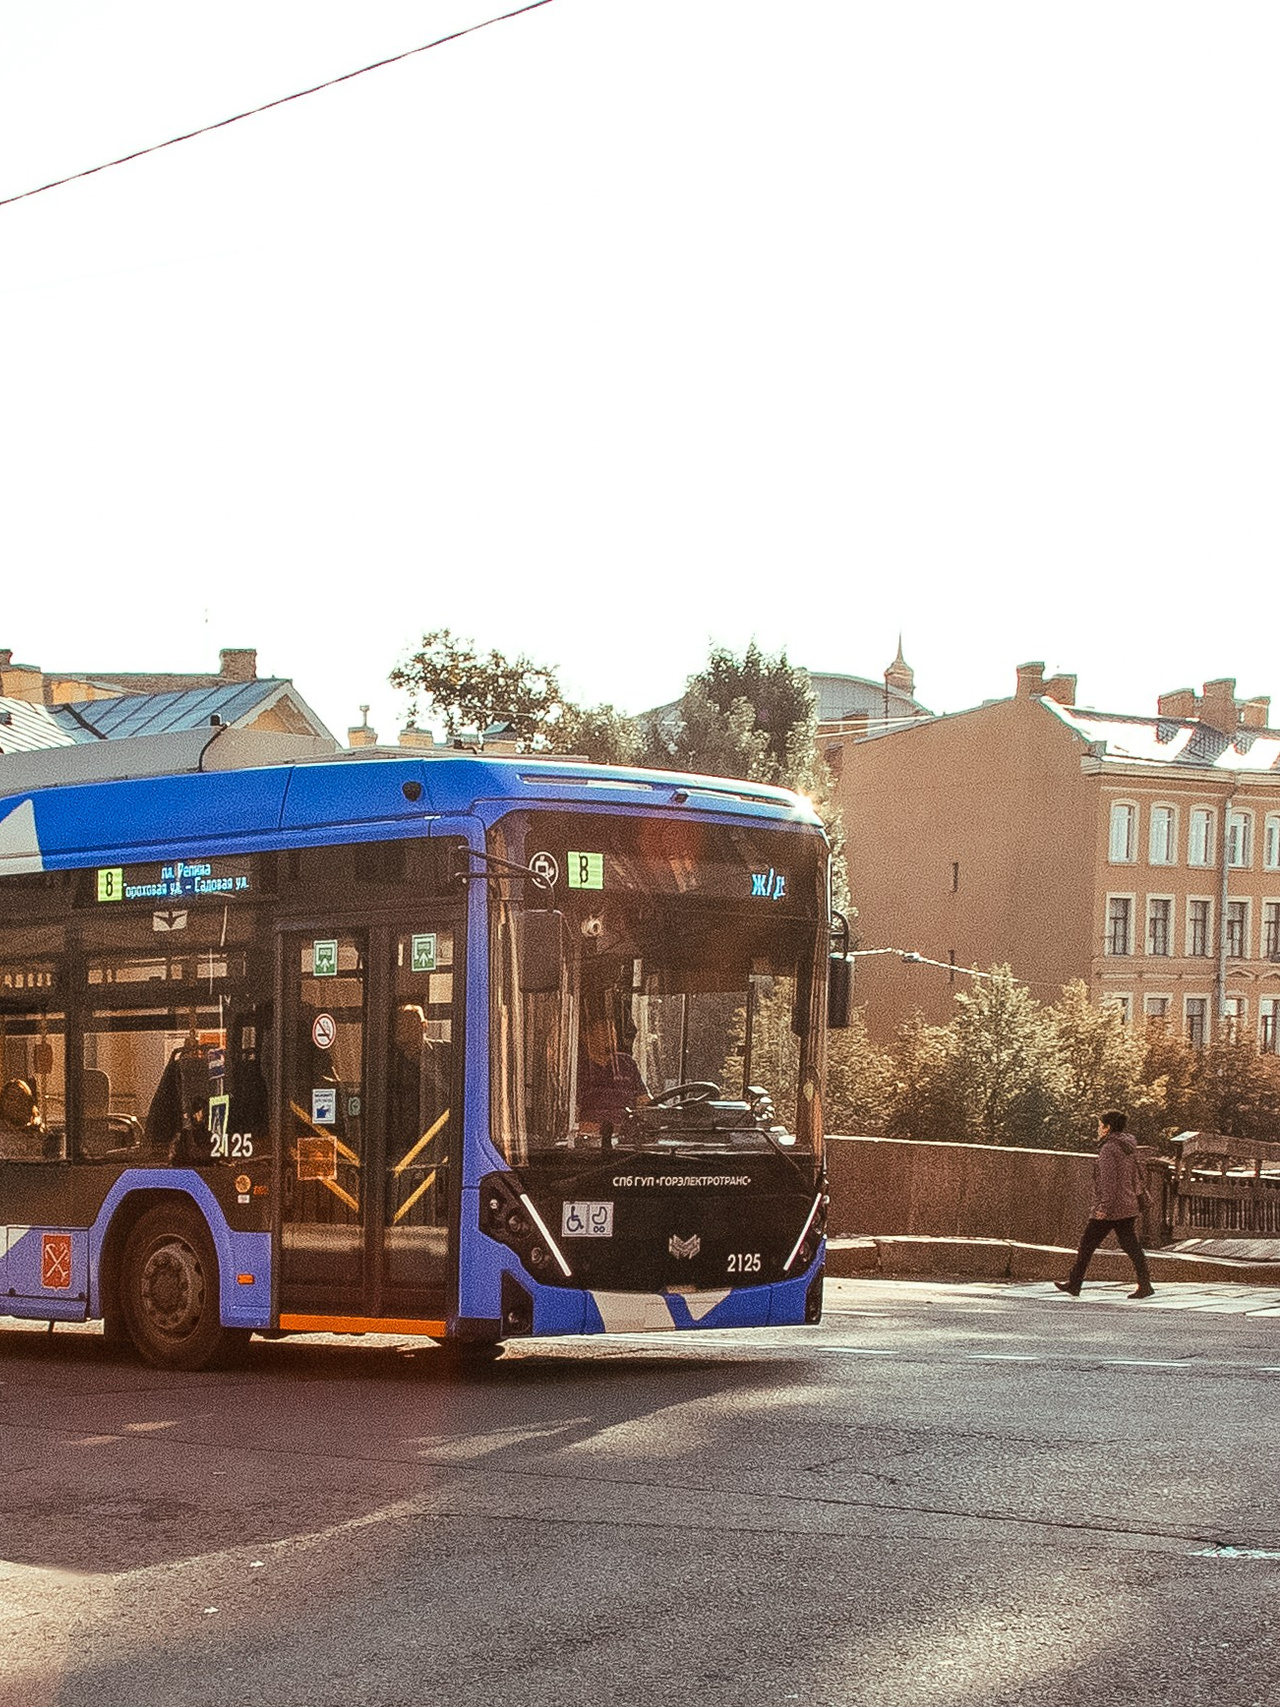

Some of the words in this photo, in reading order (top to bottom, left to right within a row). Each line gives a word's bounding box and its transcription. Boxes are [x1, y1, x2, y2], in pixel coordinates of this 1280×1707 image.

[177, 862, 211, 879] Репина
[105, 871, 114, 897] 8
[123, 882, 168, 899] ороховая
[194, 876, 233, 893] Садовая
[210, 1133, 253, 1157] 2125
[612, 1176, 633, 1187] СПб
[634, 1176, 654, 1187] ГУП
[727, 1253, 761, 1272] 2125
